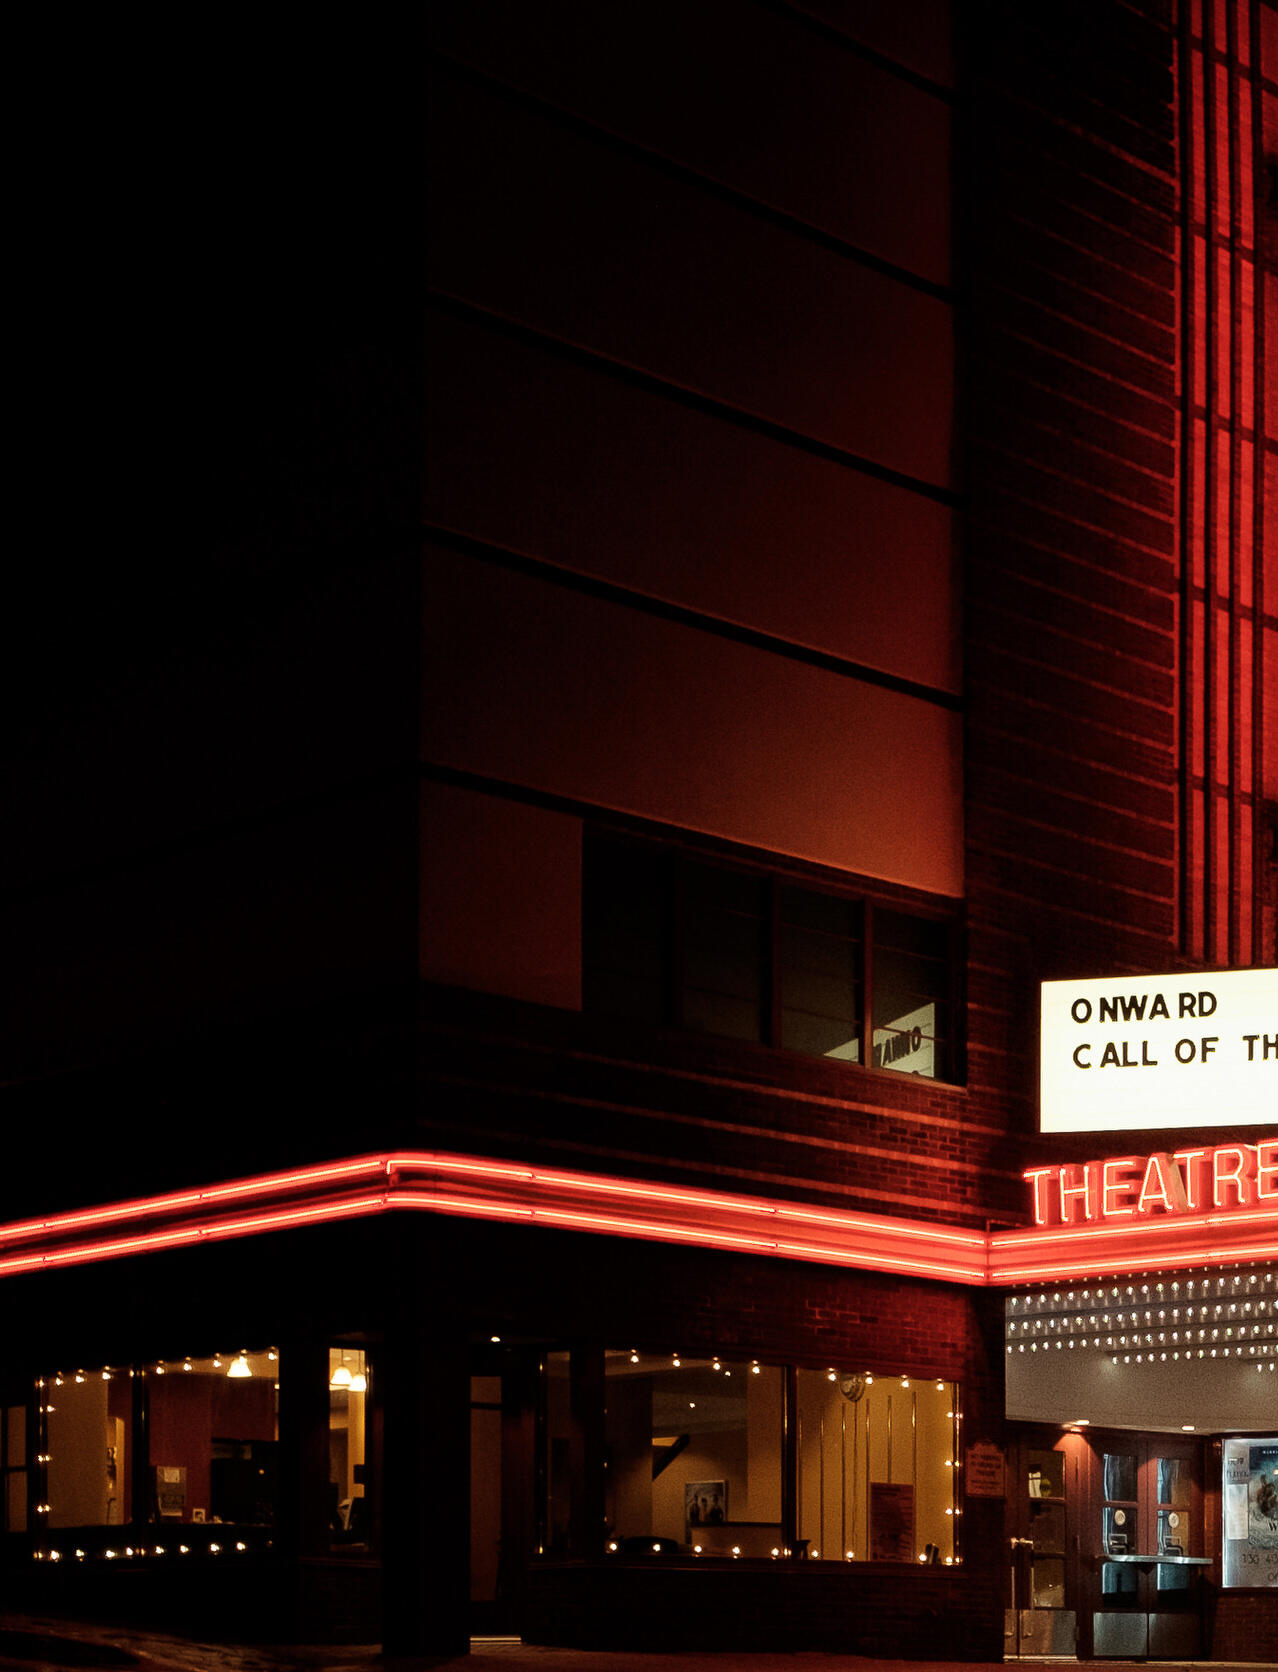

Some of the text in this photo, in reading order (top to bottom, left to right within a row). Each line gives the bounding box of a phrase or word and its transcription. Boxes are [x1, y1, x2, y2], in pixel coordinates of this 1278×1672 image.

[1071, 991, 1218, 1024] ONWARD
[1073, 1041, 1158, 1069] CALL
[1175, 1037, 1219, 1064] OF
